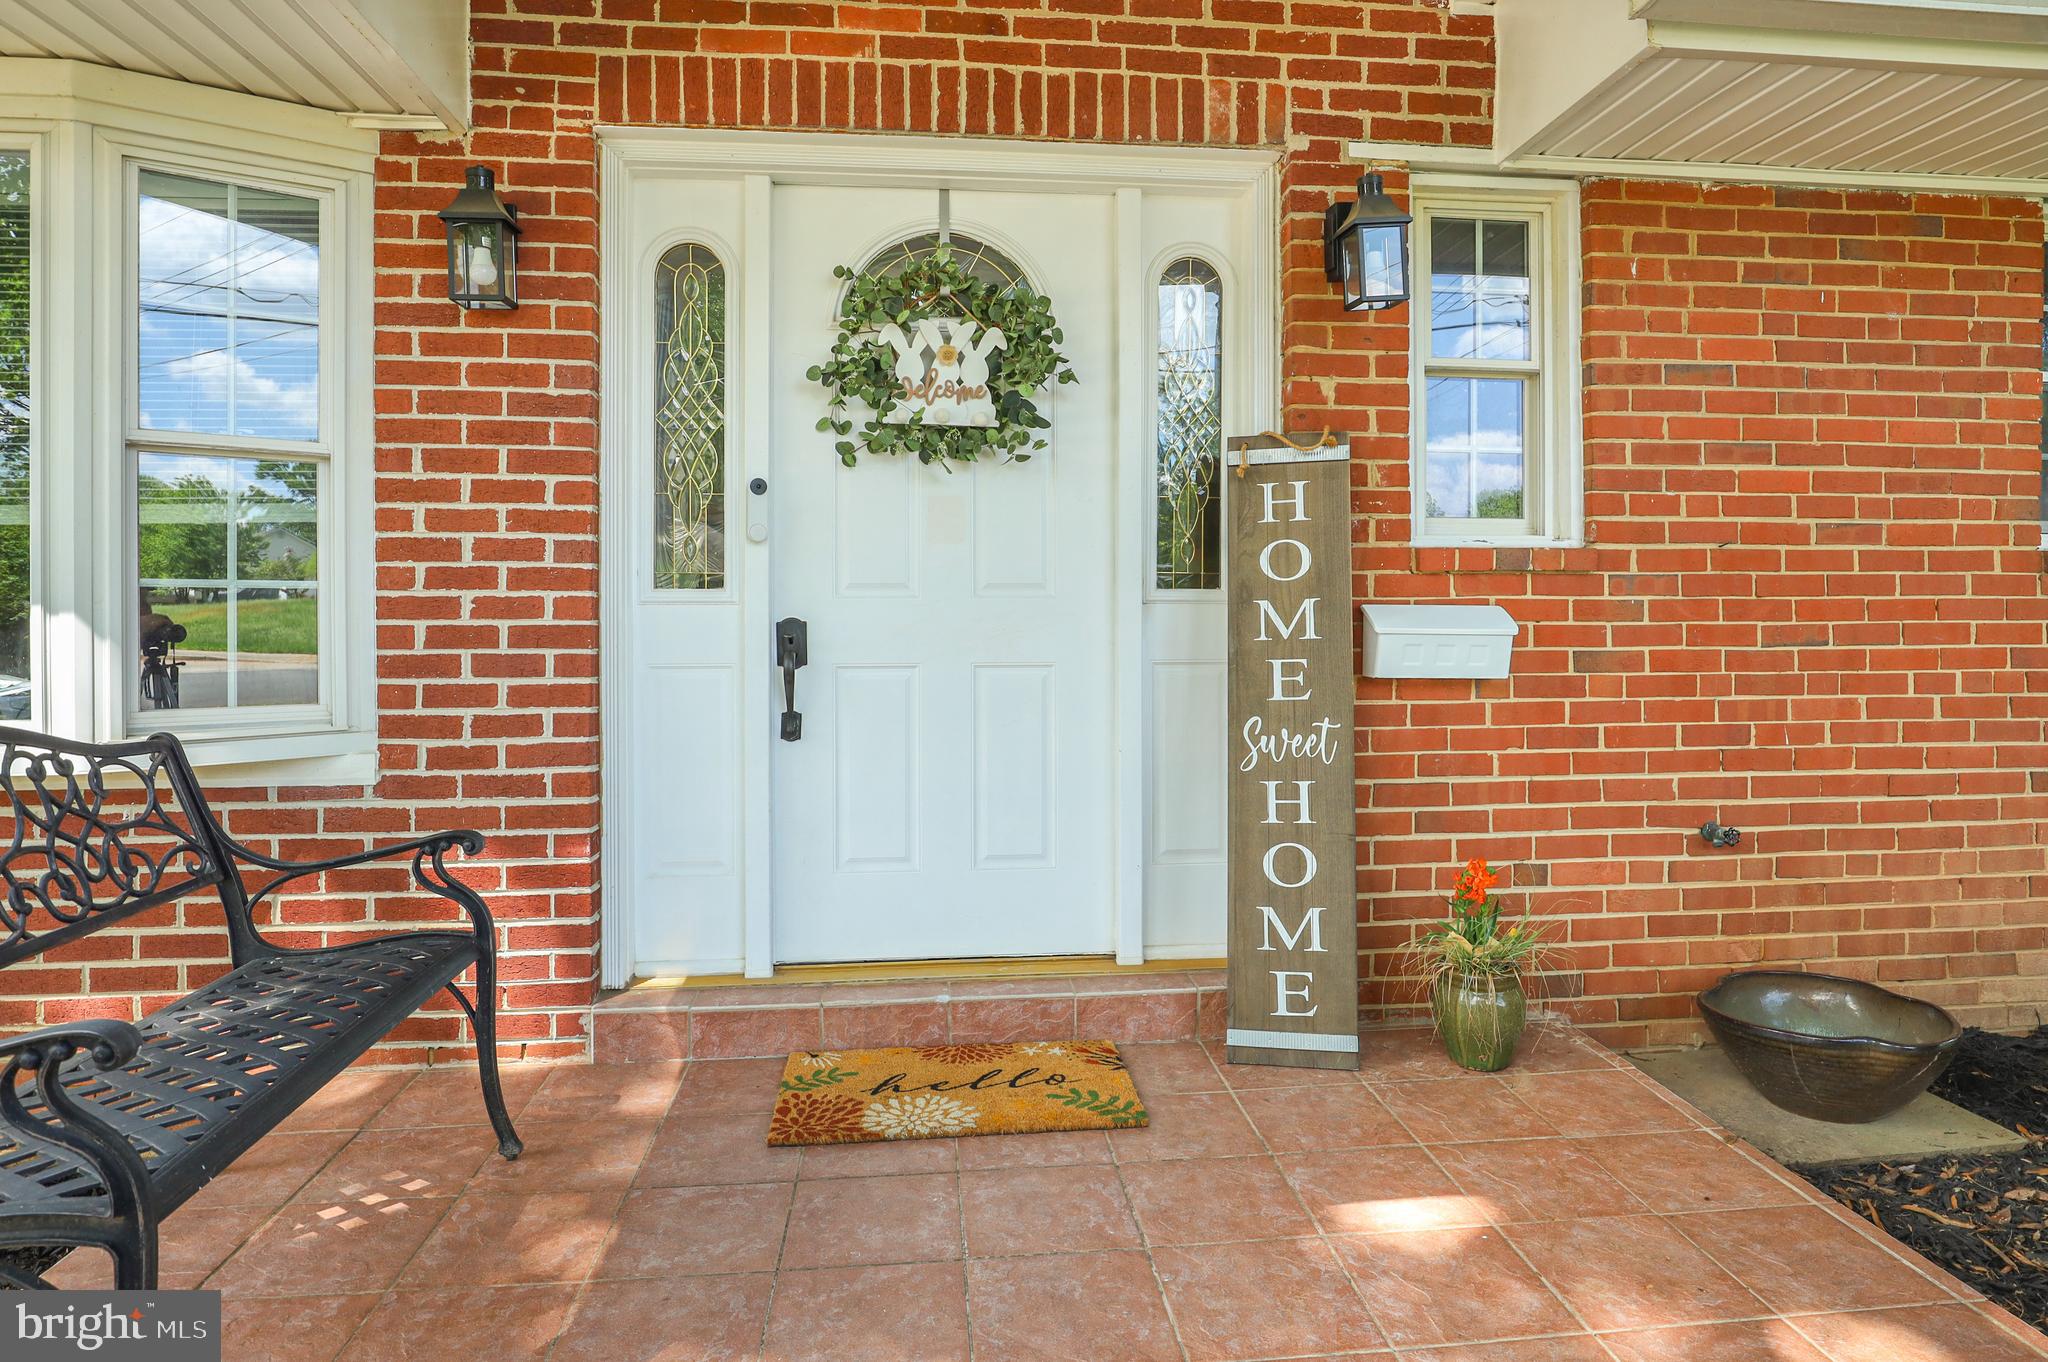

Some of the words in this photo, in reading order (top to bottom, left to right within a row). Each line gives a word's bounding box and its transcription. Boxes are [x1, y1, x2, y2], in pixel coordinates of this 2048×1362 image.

[1253, 480, 1323, 702] HOME
[1240, 716, 1341, 772] Sweet
[1256, 780, 1329, 1017] HOME
[860, 1067, 1082, 1096] hello
